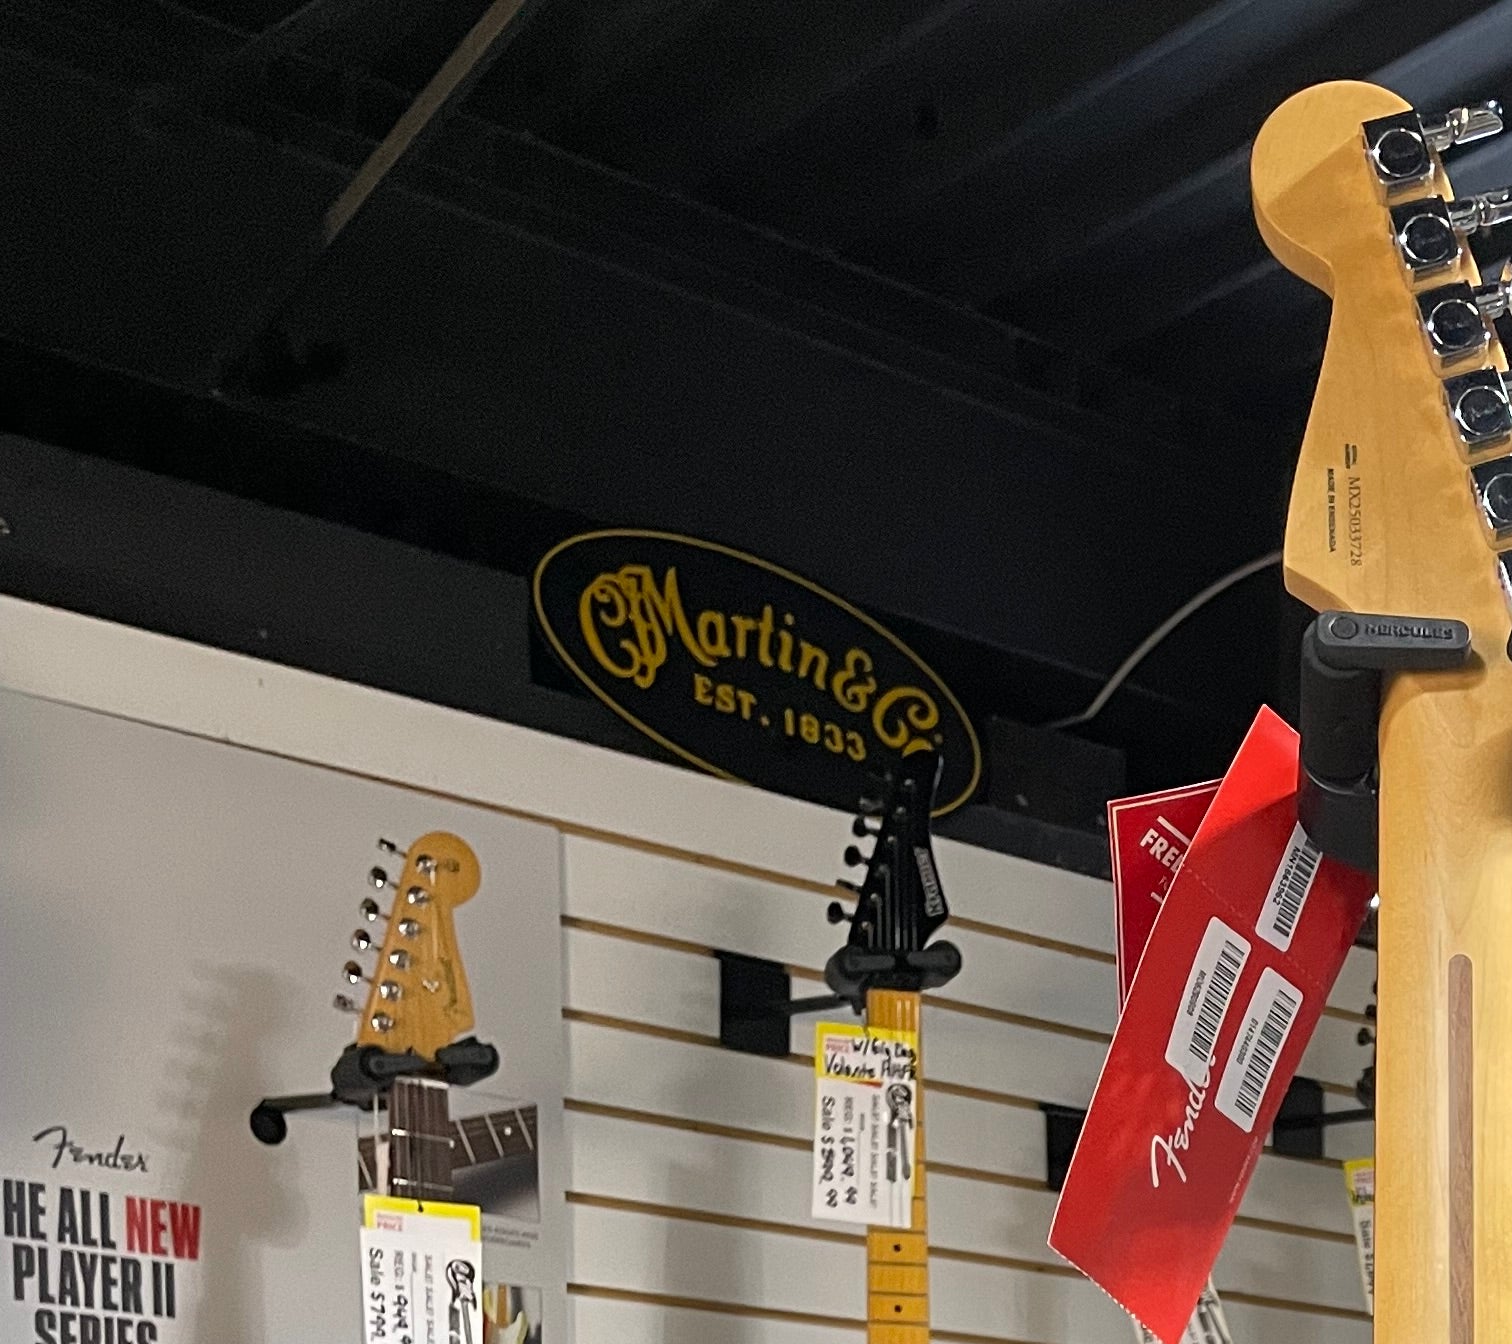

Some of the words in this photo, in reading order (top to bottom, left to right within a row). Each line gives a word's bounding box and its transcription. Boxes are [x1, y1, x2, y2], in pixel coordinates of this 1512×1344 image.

[783, 707, 867, 763] 1833
[33, 1126, 149, 1173] Fender
[1151, 1054, 1217, 1189] Fend
[2, 1179, 47, 1239] HE
[57, 1186, 116, 1251] ALL
[125, 1195, 201, 1261] NEW
[12, 1243, 146, 1316] PLAYER
[152, 1262, 177, 1319] II
